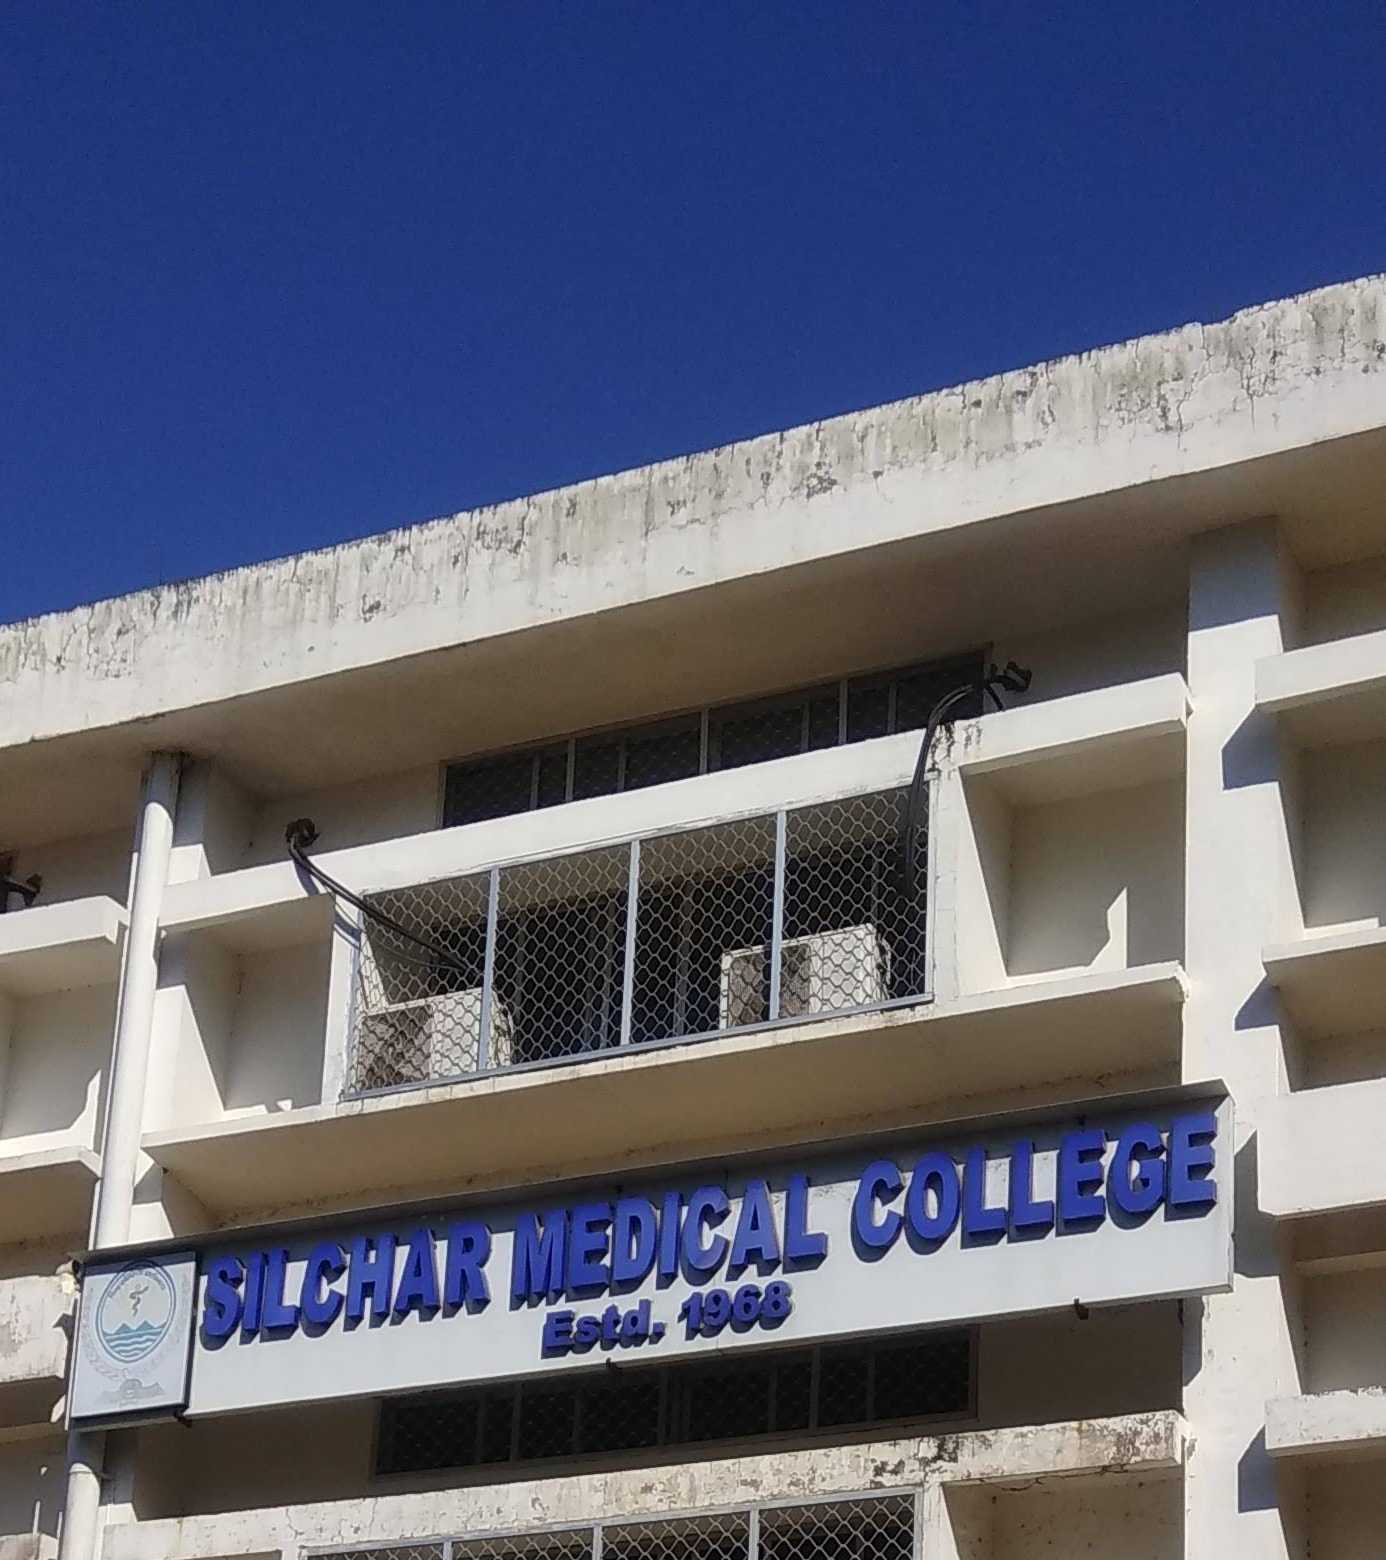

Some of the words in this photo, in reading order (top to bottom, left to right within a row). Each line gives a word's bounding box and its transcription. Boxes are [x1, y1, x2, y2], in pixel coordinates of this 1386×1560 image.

[202, 1221, 493, 1346] SILCHAR
[511, 1172, 828, 1310] MEDICAL
[852, 1112, 1219, 1262] COLLEGE
[541, 1299, 665, 1358] Estd.
[679, 1280, 796, 1342] 1968
